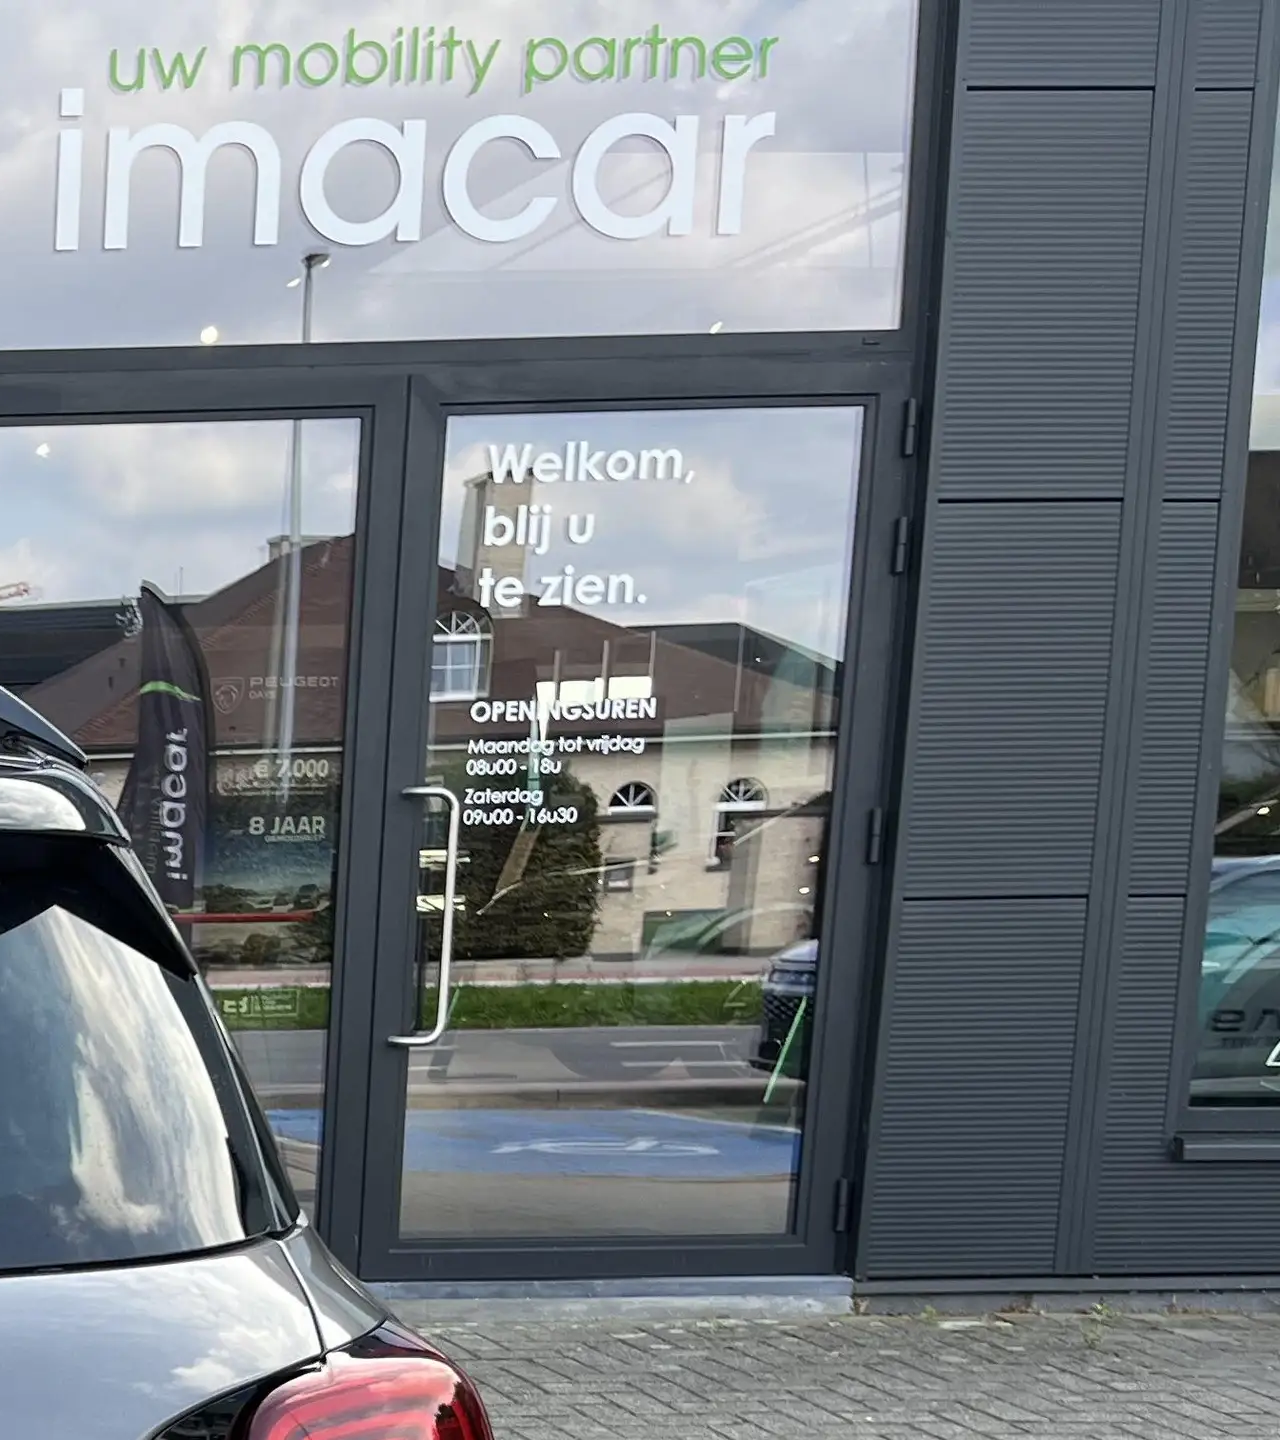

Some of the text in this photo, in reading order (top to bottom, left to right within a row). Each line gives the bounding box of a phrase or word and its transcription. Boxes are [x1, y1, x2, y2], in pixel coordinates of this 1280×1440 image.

[108, 24, 779, 97] uw mobility partner
[53, 87, 776, 252] imacar
[488, 440, 695, 484] Welkom,
[483, 503, 595, 555] blij u
[478, 564, 647, 608] te zien.
[249, 676, 338, 688] PEUGEOT
[469, 697, 657, 723] OPENINGSUREN
[467, 735, 646, 756] Maandag tot vrijdag
[465, 758, 517, 776] 08u00
[532, 758, 562, 775] 18u
[463, 788, 544, 806] Zaterdag
[248, 816, 325, 835] 8 JAAR
[462, 809, 514, 826] 09u00
[529, 807, 578, 824] 16u30
